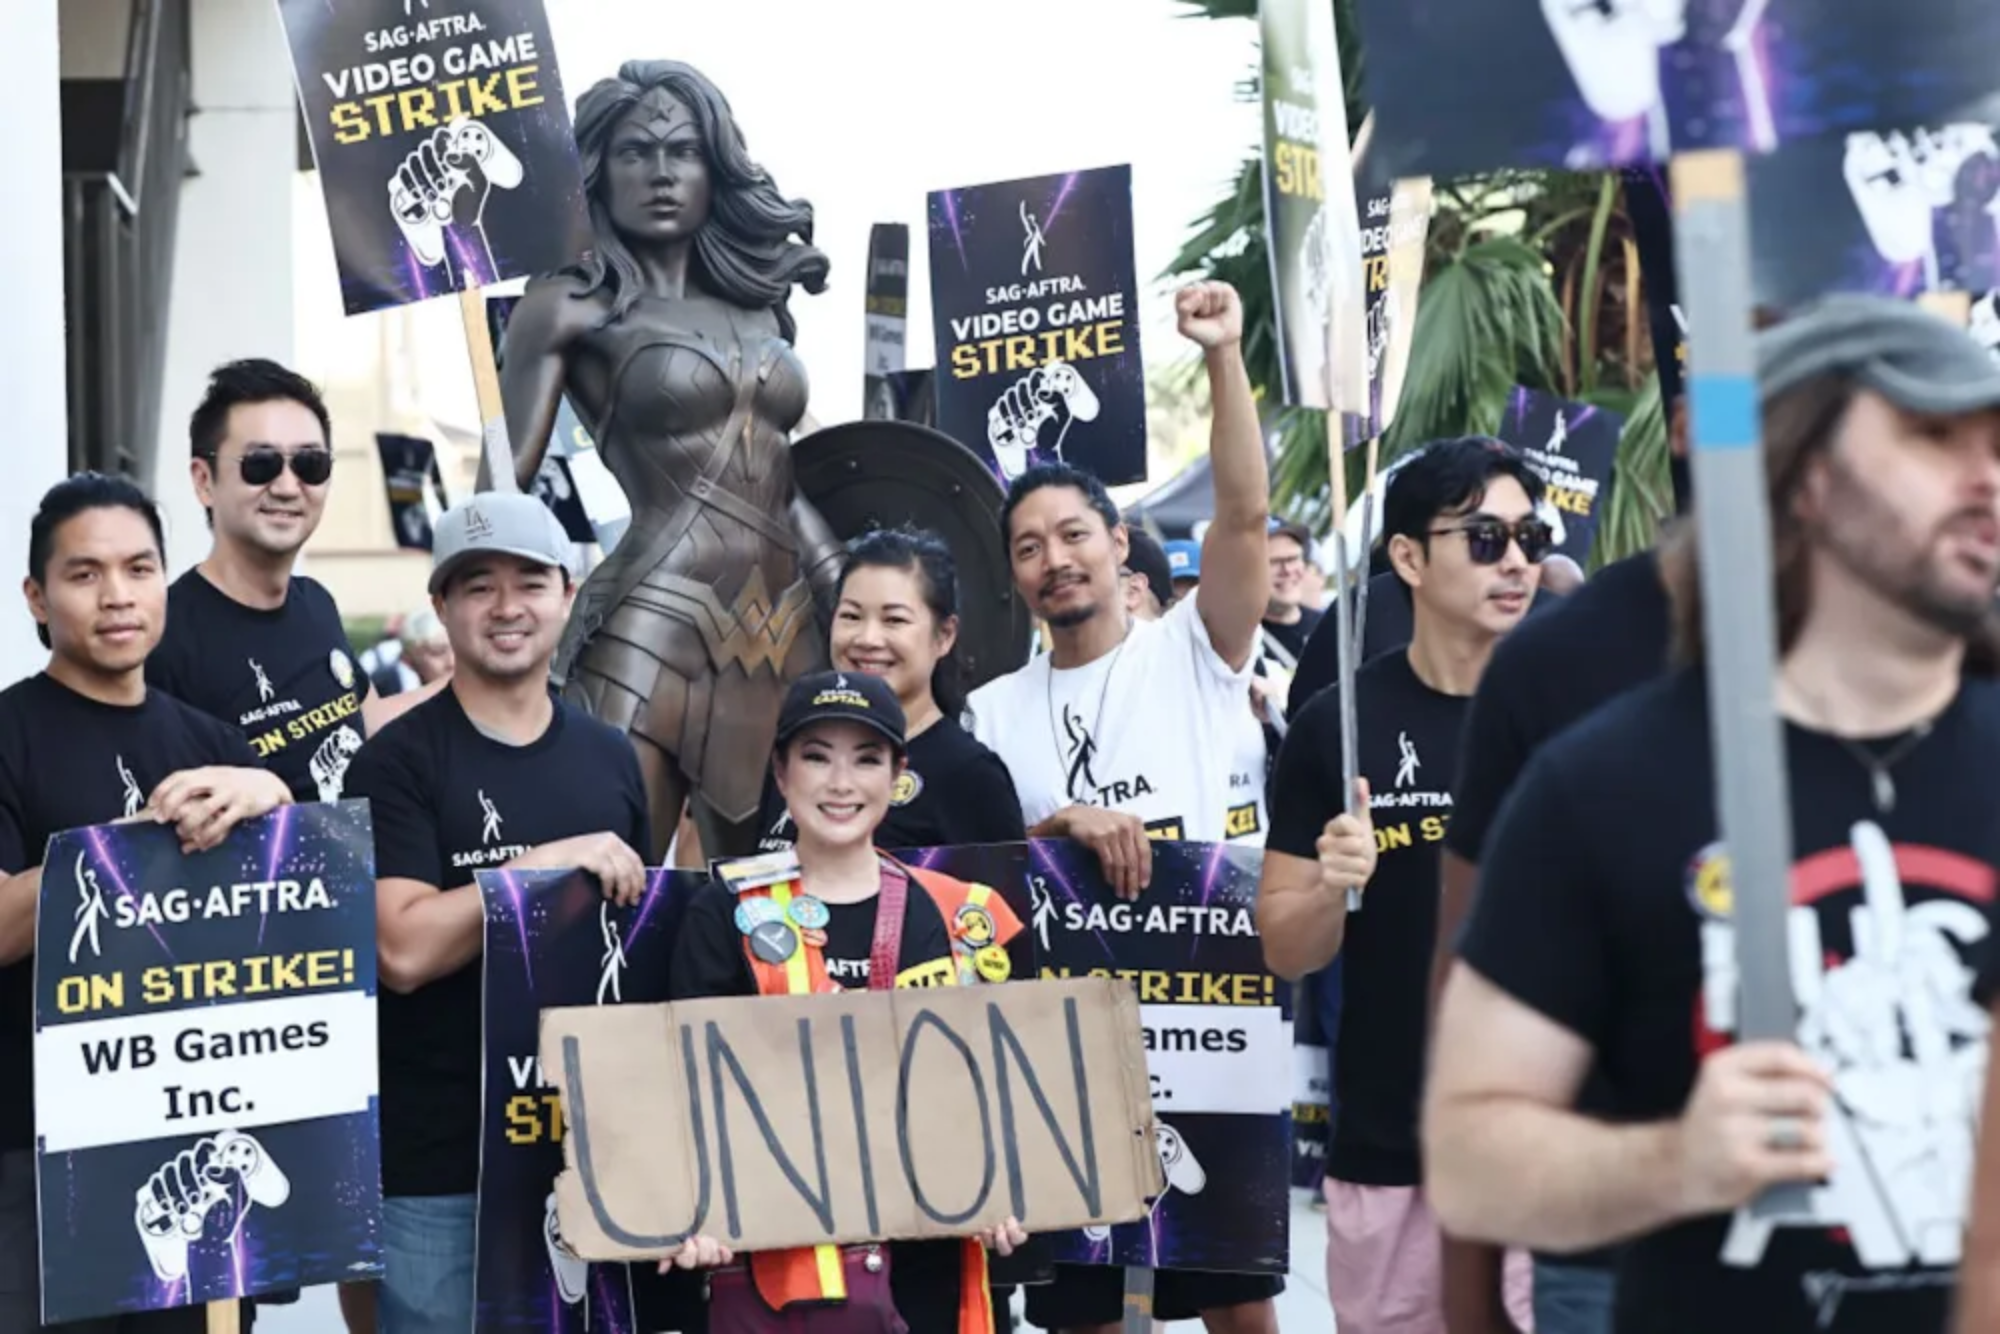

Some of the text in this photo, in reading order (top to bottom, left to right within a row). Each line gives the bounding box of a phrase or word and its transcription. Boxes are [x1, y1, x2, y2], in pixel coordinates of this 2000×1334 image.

[322, 33, 538, 98] VIDEO GAME
[329, 65, 544, 144] STRIKE
[951, 293, 1124, 341] VIDEO GAME
[951, 320, 1125, 380] STRIKE
[57, 950, 354, 1016] ON STRIKE!
[1088, 967, 1274, 1006] RIKE!
[81, 1019, 330, 1076] WB Games
[1141, 1026, 1248, 1053] ames
[507, 1056, 545, 1089] VI
[163, 1084, 255, 1122] Inc.
[505, 1095, 561, 1144] ST
[562, 997, 1102, 1248] UNION
